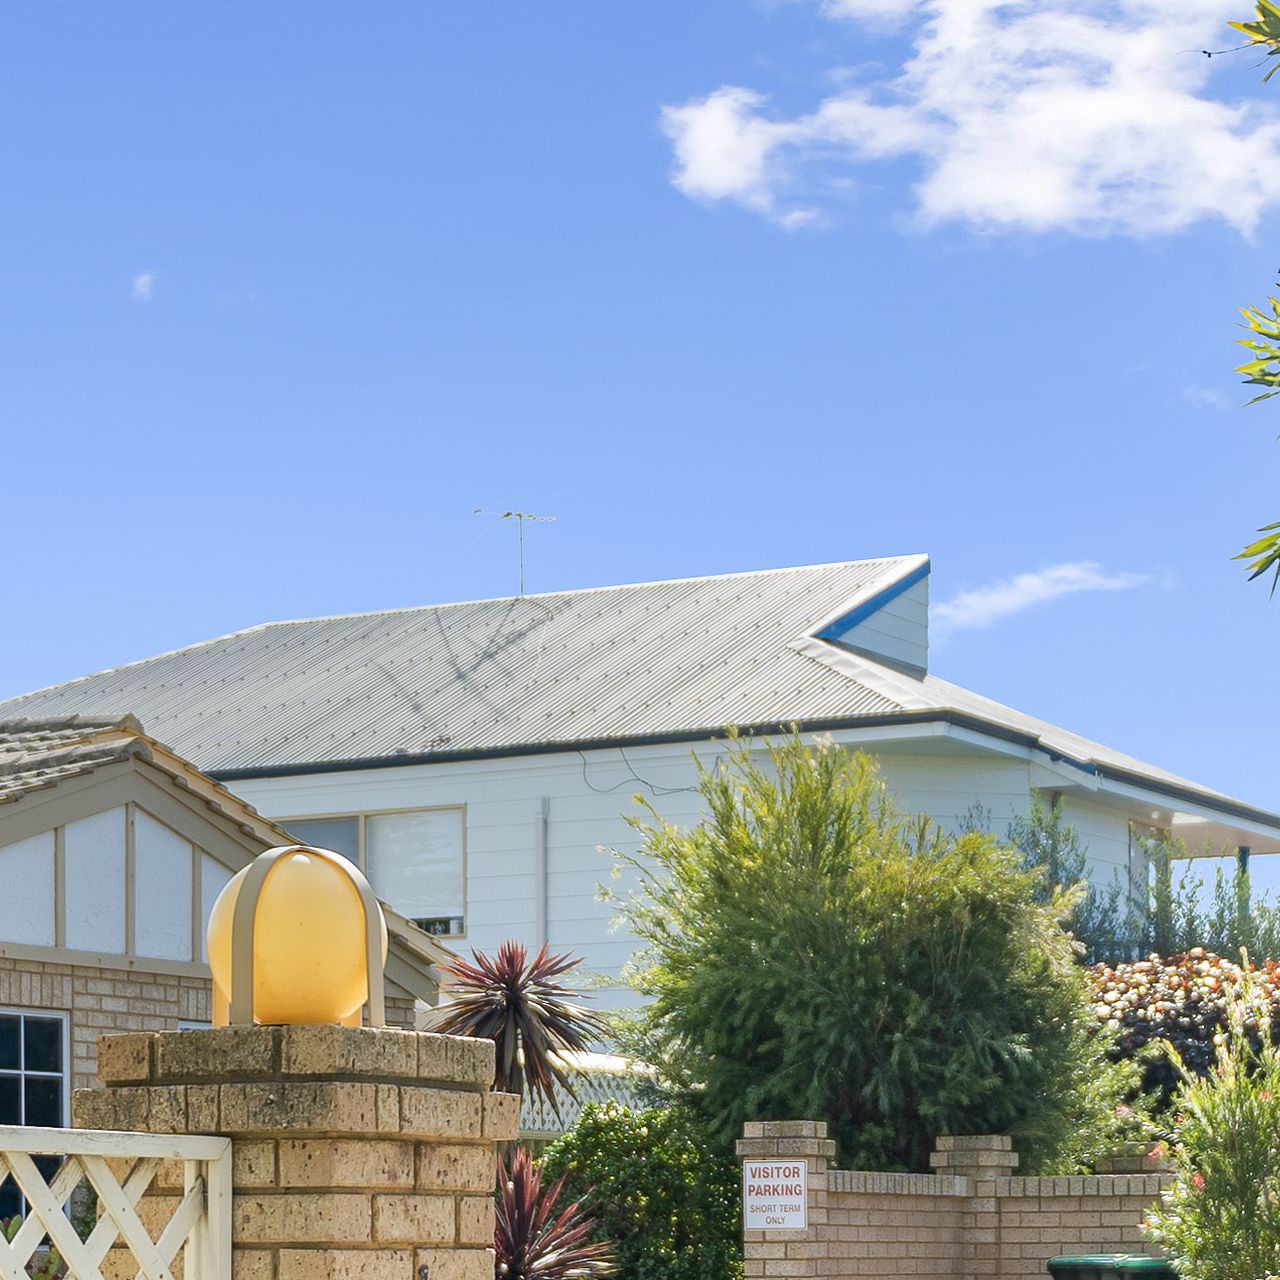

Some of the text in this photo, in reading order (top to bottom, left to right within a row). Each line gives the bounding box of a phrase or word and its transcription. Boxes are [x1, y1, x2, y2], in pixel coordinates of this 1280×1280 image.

[749, 1166, 800, 1179] VISITOR
[748, 1184, 802, 1196] PARKING
[750, 1204, 801, 1213] SHORT TERM
[765, 1216, 786, 1225] ONLY
